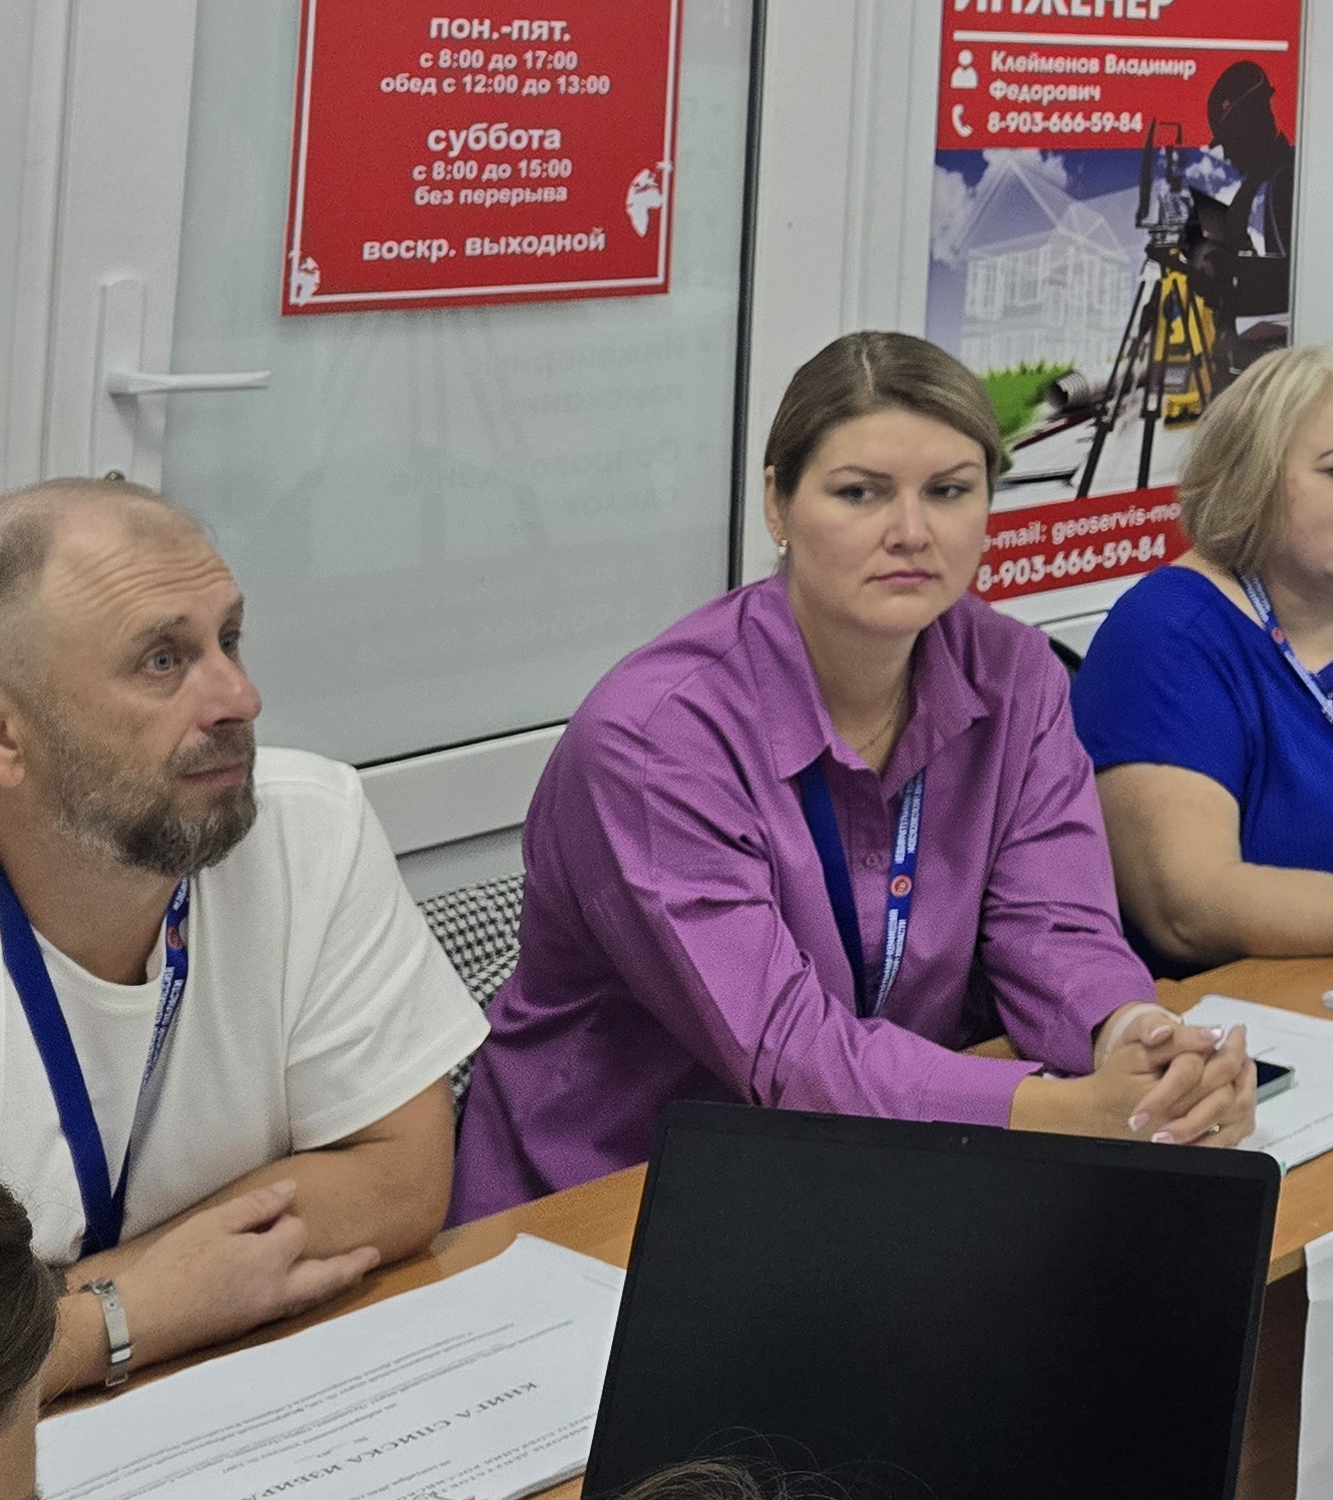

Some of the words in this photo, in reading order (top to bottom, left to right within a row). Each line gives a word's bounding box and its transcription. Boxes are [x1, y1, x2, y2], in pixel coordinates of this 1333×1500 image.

[419, 52, 433, 68] с
[438, 49, 484, 70] 8:00
[488, 54, 517, 72] до
[523, 50, 578, 71] 17:00
[990, 50, 1100, 76] Клейменов
[1104, 53, 1198, 80] Владимир
[380, 73, 437, 95] обед
[442, 77, 456, 93] с
[462, 73, 518, 94] 12:00
[522, 78, 551, 97] до
[557, 75, 611, 95] 13:00
[988, 79, 1101, 105] Федорович
[986, 111, 1143, 135] 8-903-666-59-84
[427, 122, 562, 158] суббота
[411, 164, 427, 181] с
[432, 160, 478, 181] 8:00
[482, 163, 512, 182] до
[518, 158, 572, 179] 15:00
[413, 185, 454, 206] без
[459, 186, 568, 208] перерыва
[362, 238, 456, 263] воскр.
[465, 227, 606, 257] выходной
[976, 533, 1166, 592] 8-903-666-59-84
[456, 1381, 538, 1418] КНИГА
[345, 1418, 452, 1464] СПИСКА
